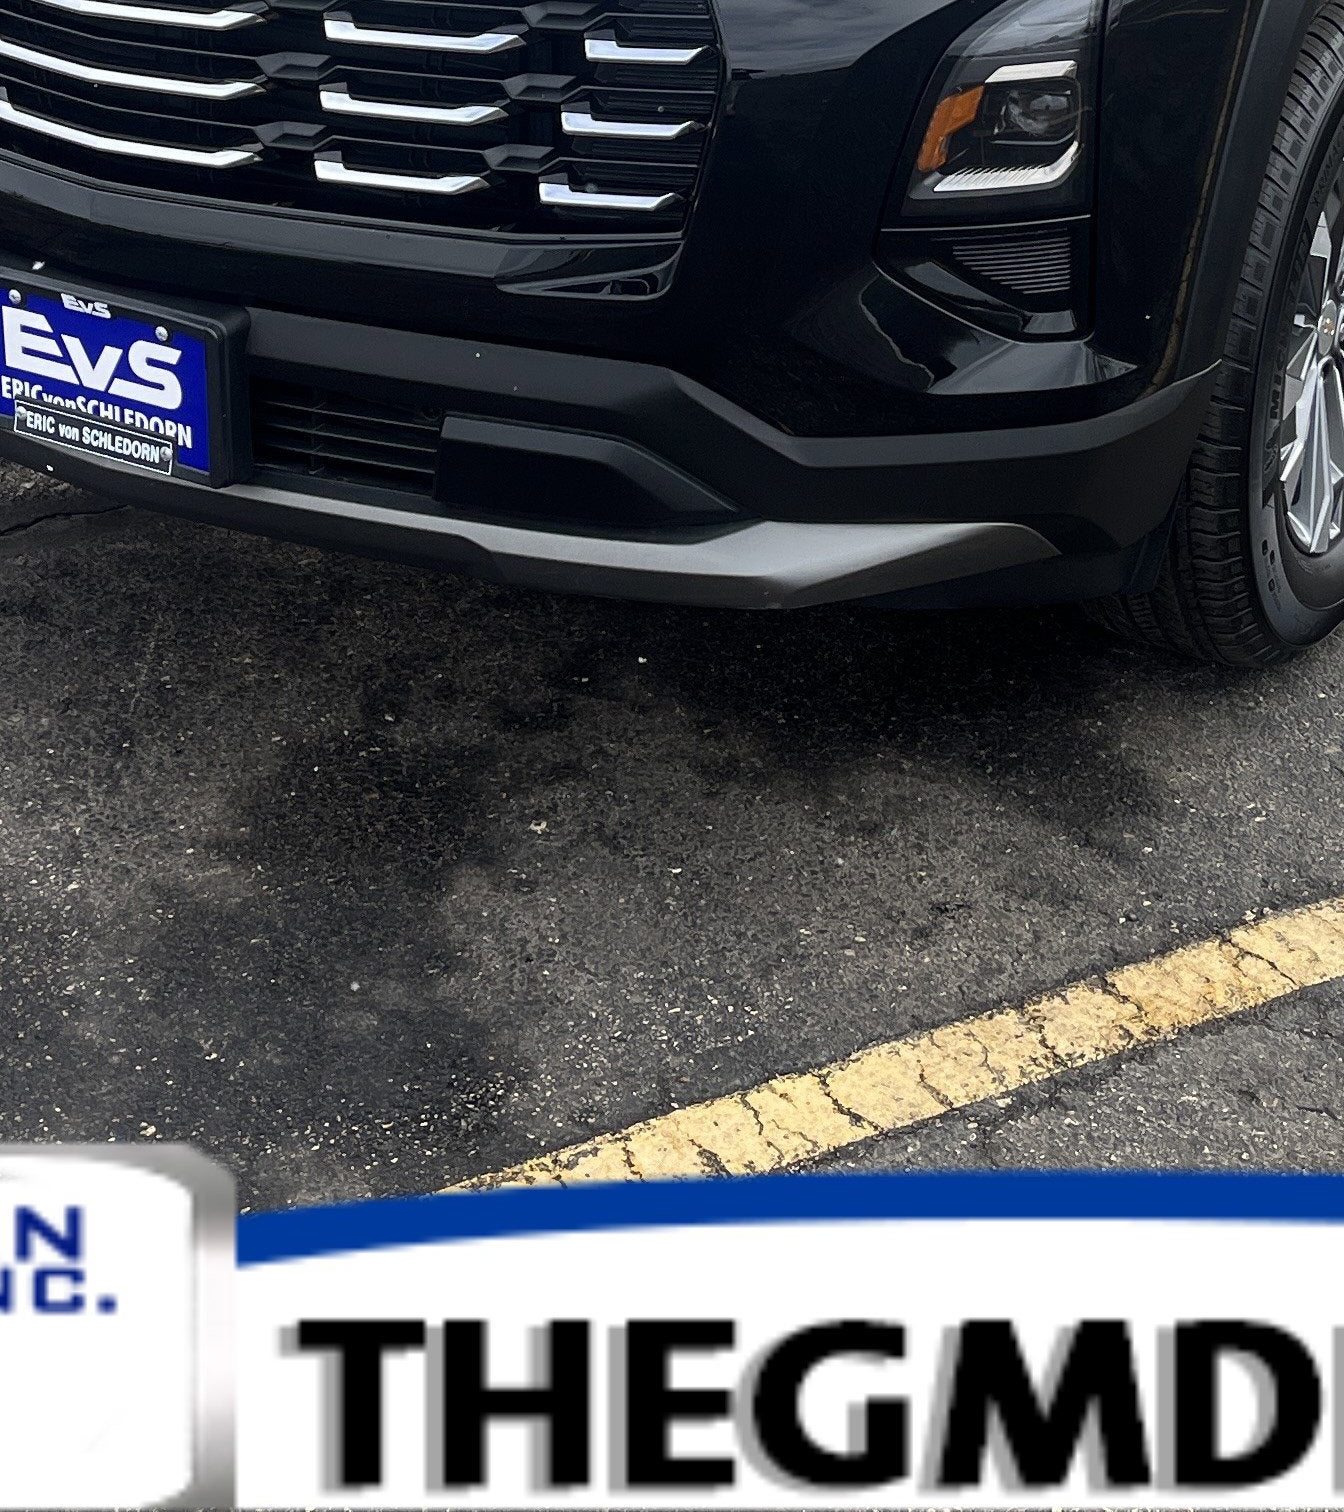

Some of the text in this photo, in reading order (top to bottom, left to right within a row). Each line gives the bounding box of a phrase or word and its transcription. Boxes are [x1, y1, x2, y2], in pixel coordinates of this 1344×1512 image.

[26, 410, 160, 464] ERIC von SCHLEDORN
